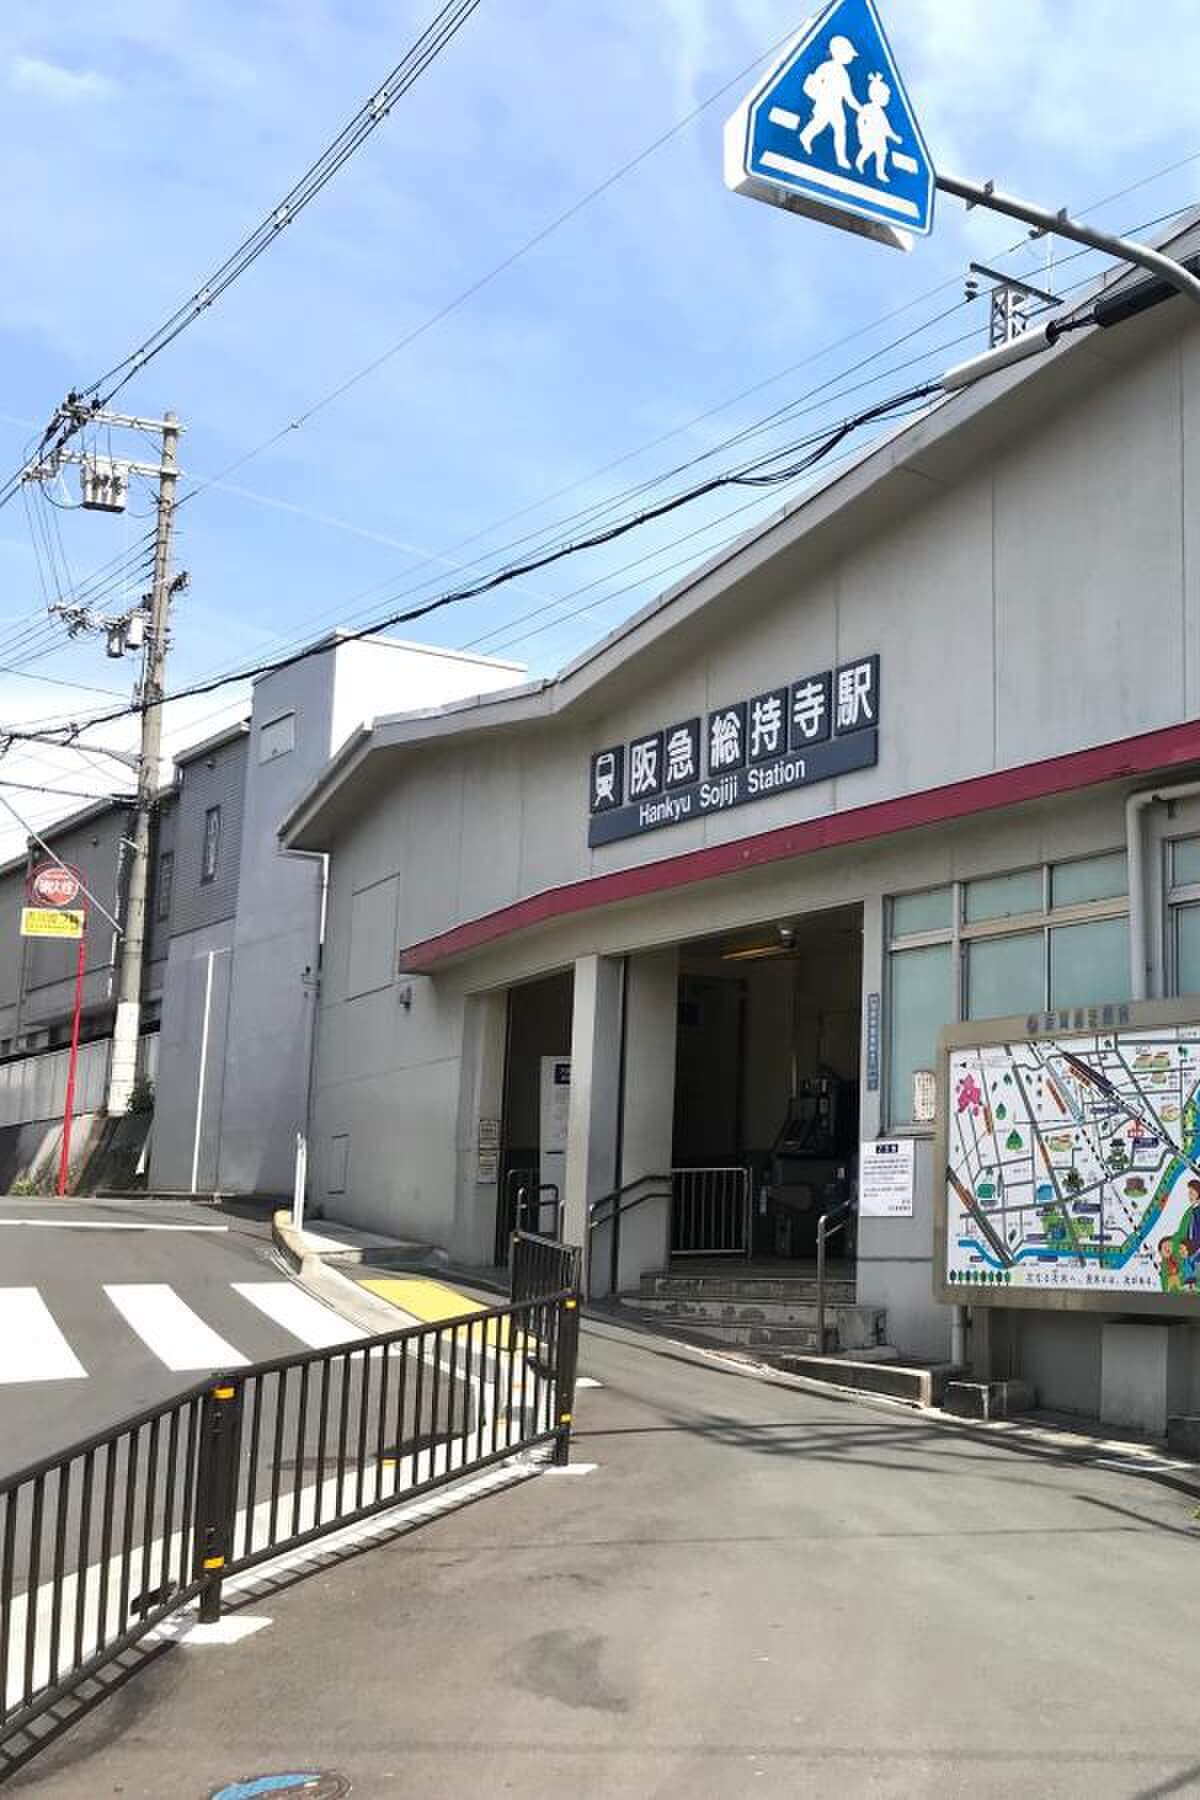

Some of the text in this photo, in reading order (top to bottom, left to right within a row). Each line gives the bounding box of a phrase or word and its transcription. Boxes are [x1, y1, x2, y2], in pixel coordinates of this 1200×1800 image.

[631, 663, 873, 796] 阪急総持寺駅
[639, 758, 806, 826] Hankyu Sojiji Station
